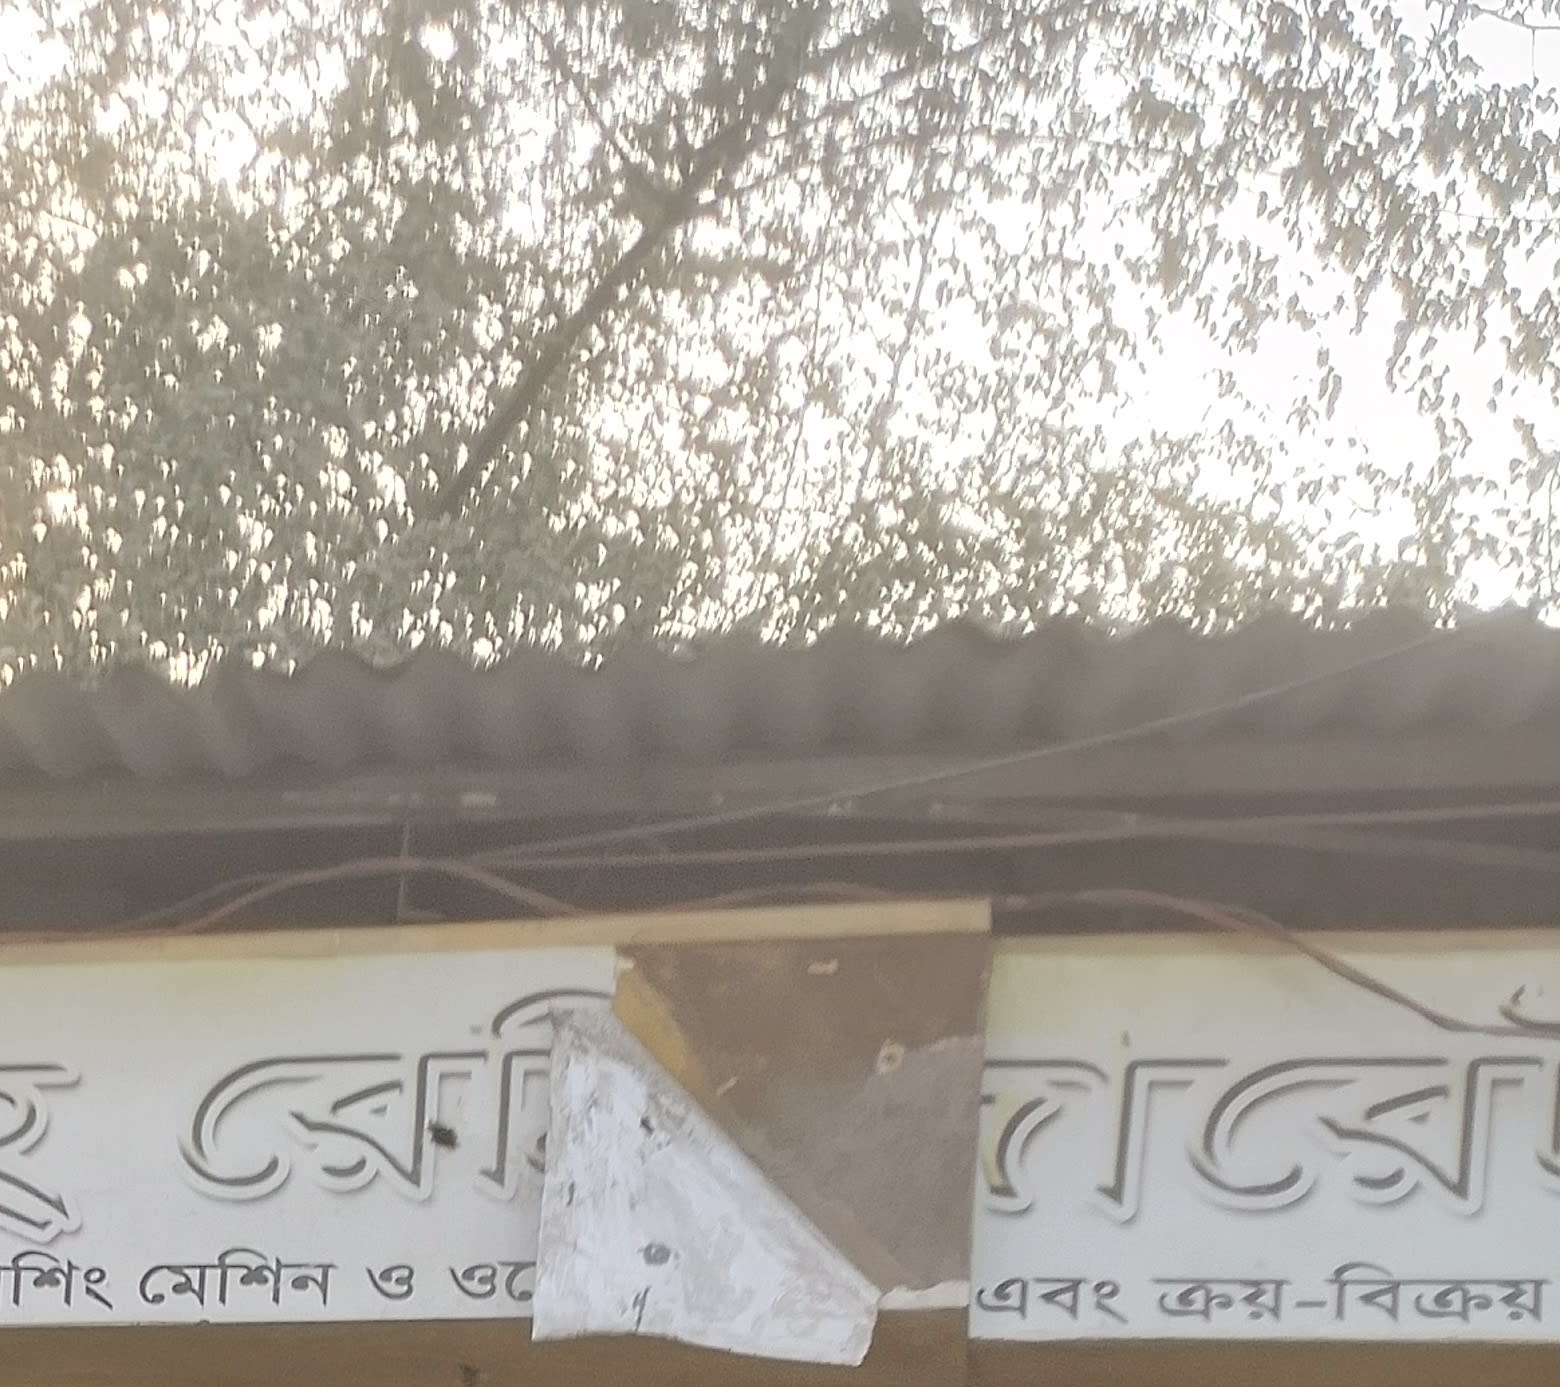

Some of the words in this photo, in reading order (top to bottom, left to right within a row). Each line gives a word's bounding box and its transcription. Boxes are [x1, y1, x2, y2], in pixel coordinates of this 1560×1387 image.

[140, 1248, 336, 1307] মেশিন
[366, 1263, 415, 1300] ও
[976, 1276, 1128, 1323] এবং
